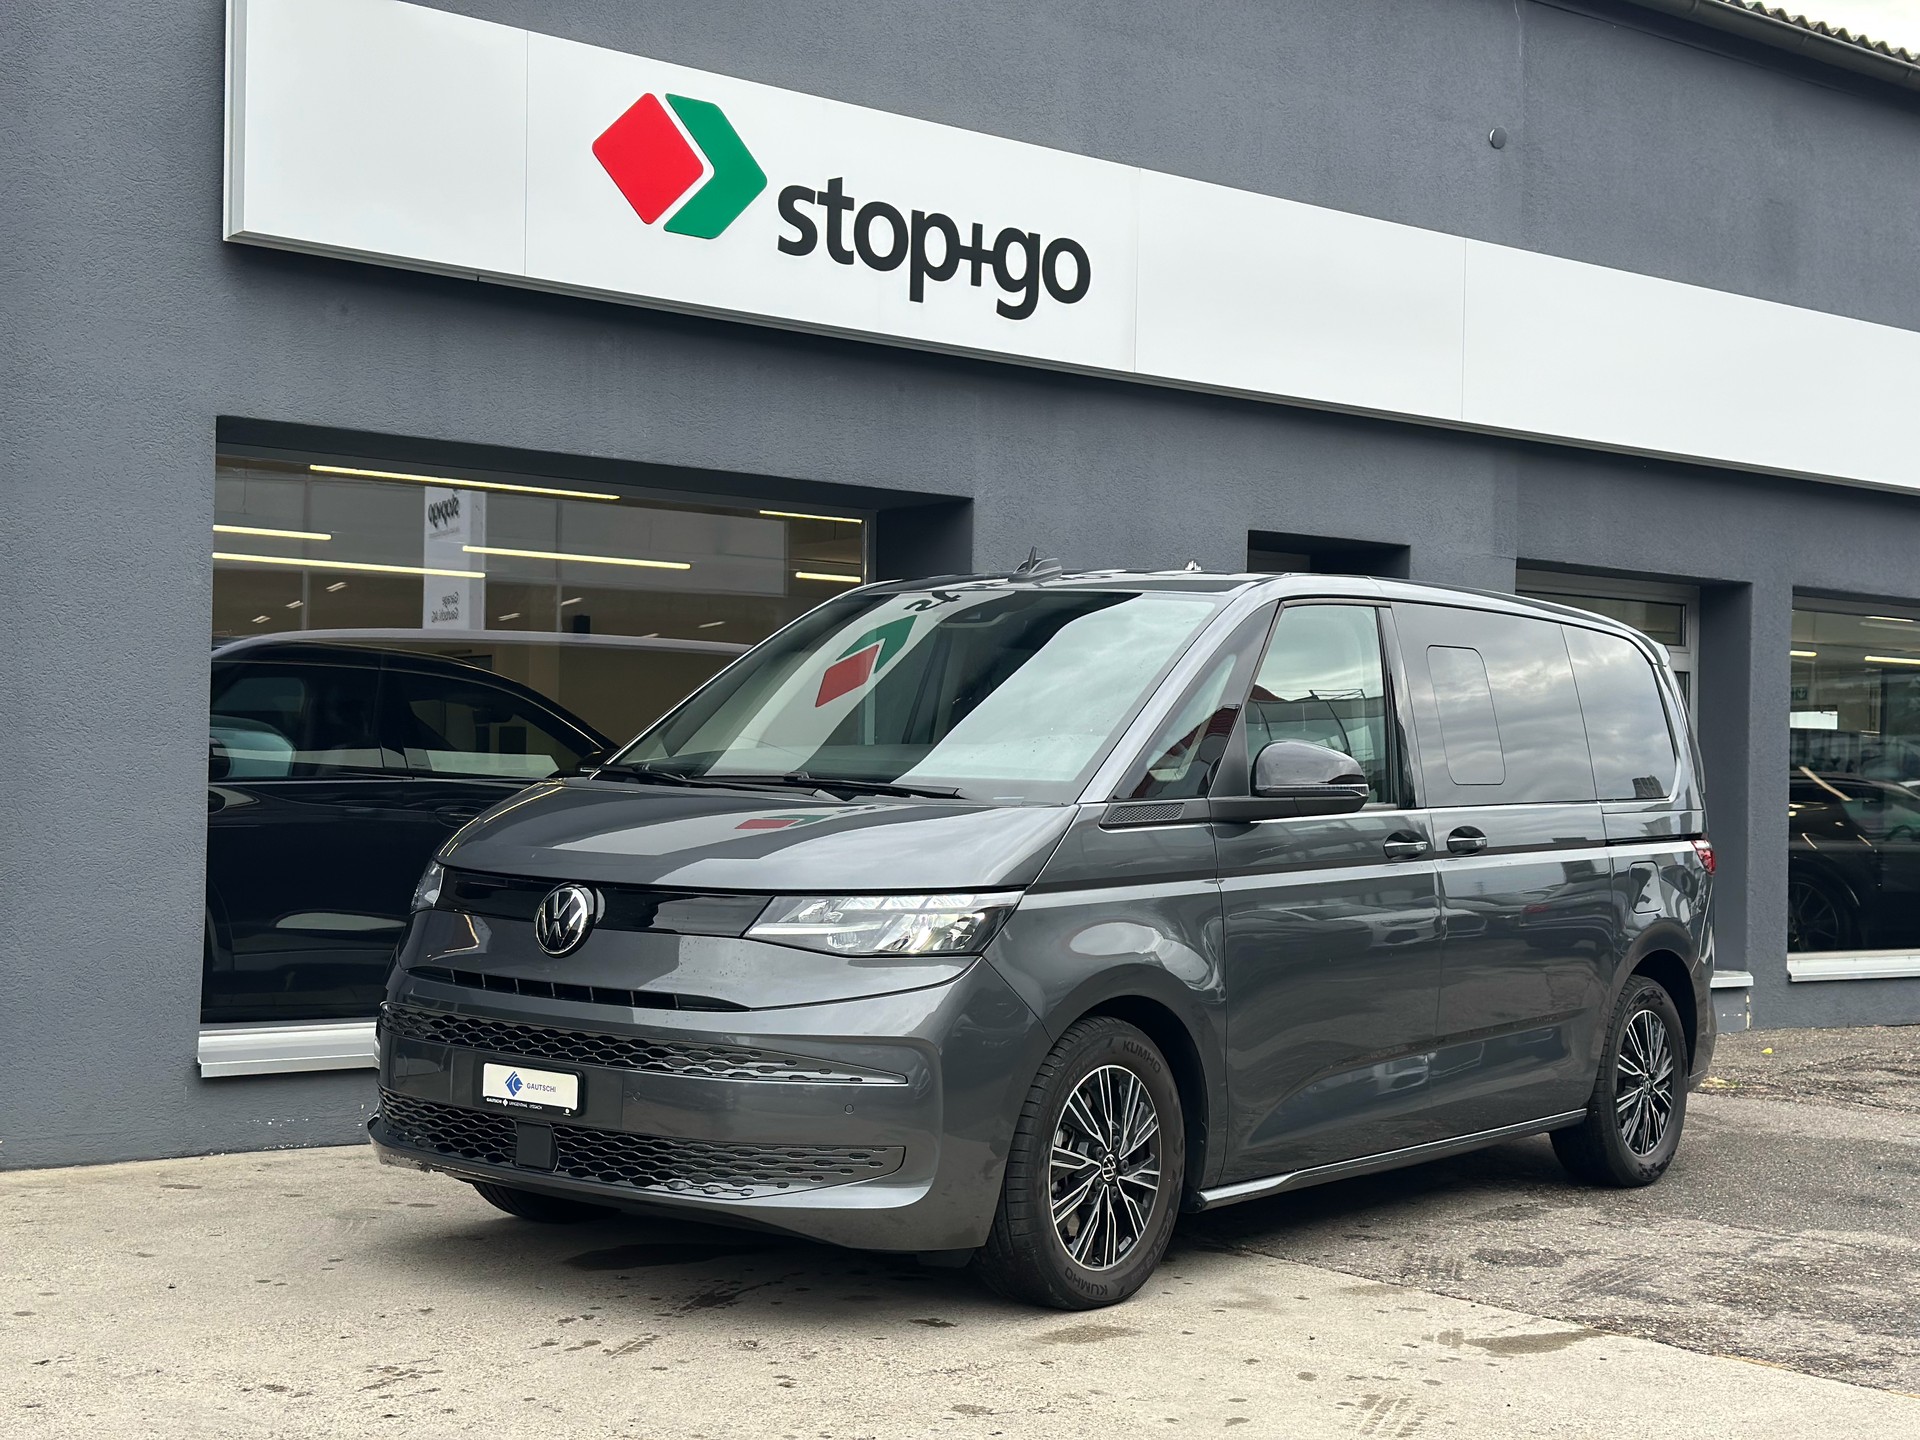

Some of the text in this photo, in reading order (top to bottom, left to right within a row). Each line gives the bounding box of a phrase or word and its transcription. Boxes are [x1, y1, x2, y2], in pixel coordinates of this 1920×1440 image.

[777, 176, 1091, 320] stop+go
[1122, 1040, 1161, 1073] KUMHO
[527, 1083, 556, 1092] GAUTSCHI
[1065, 1267, 1108, 1296] KUMHO
